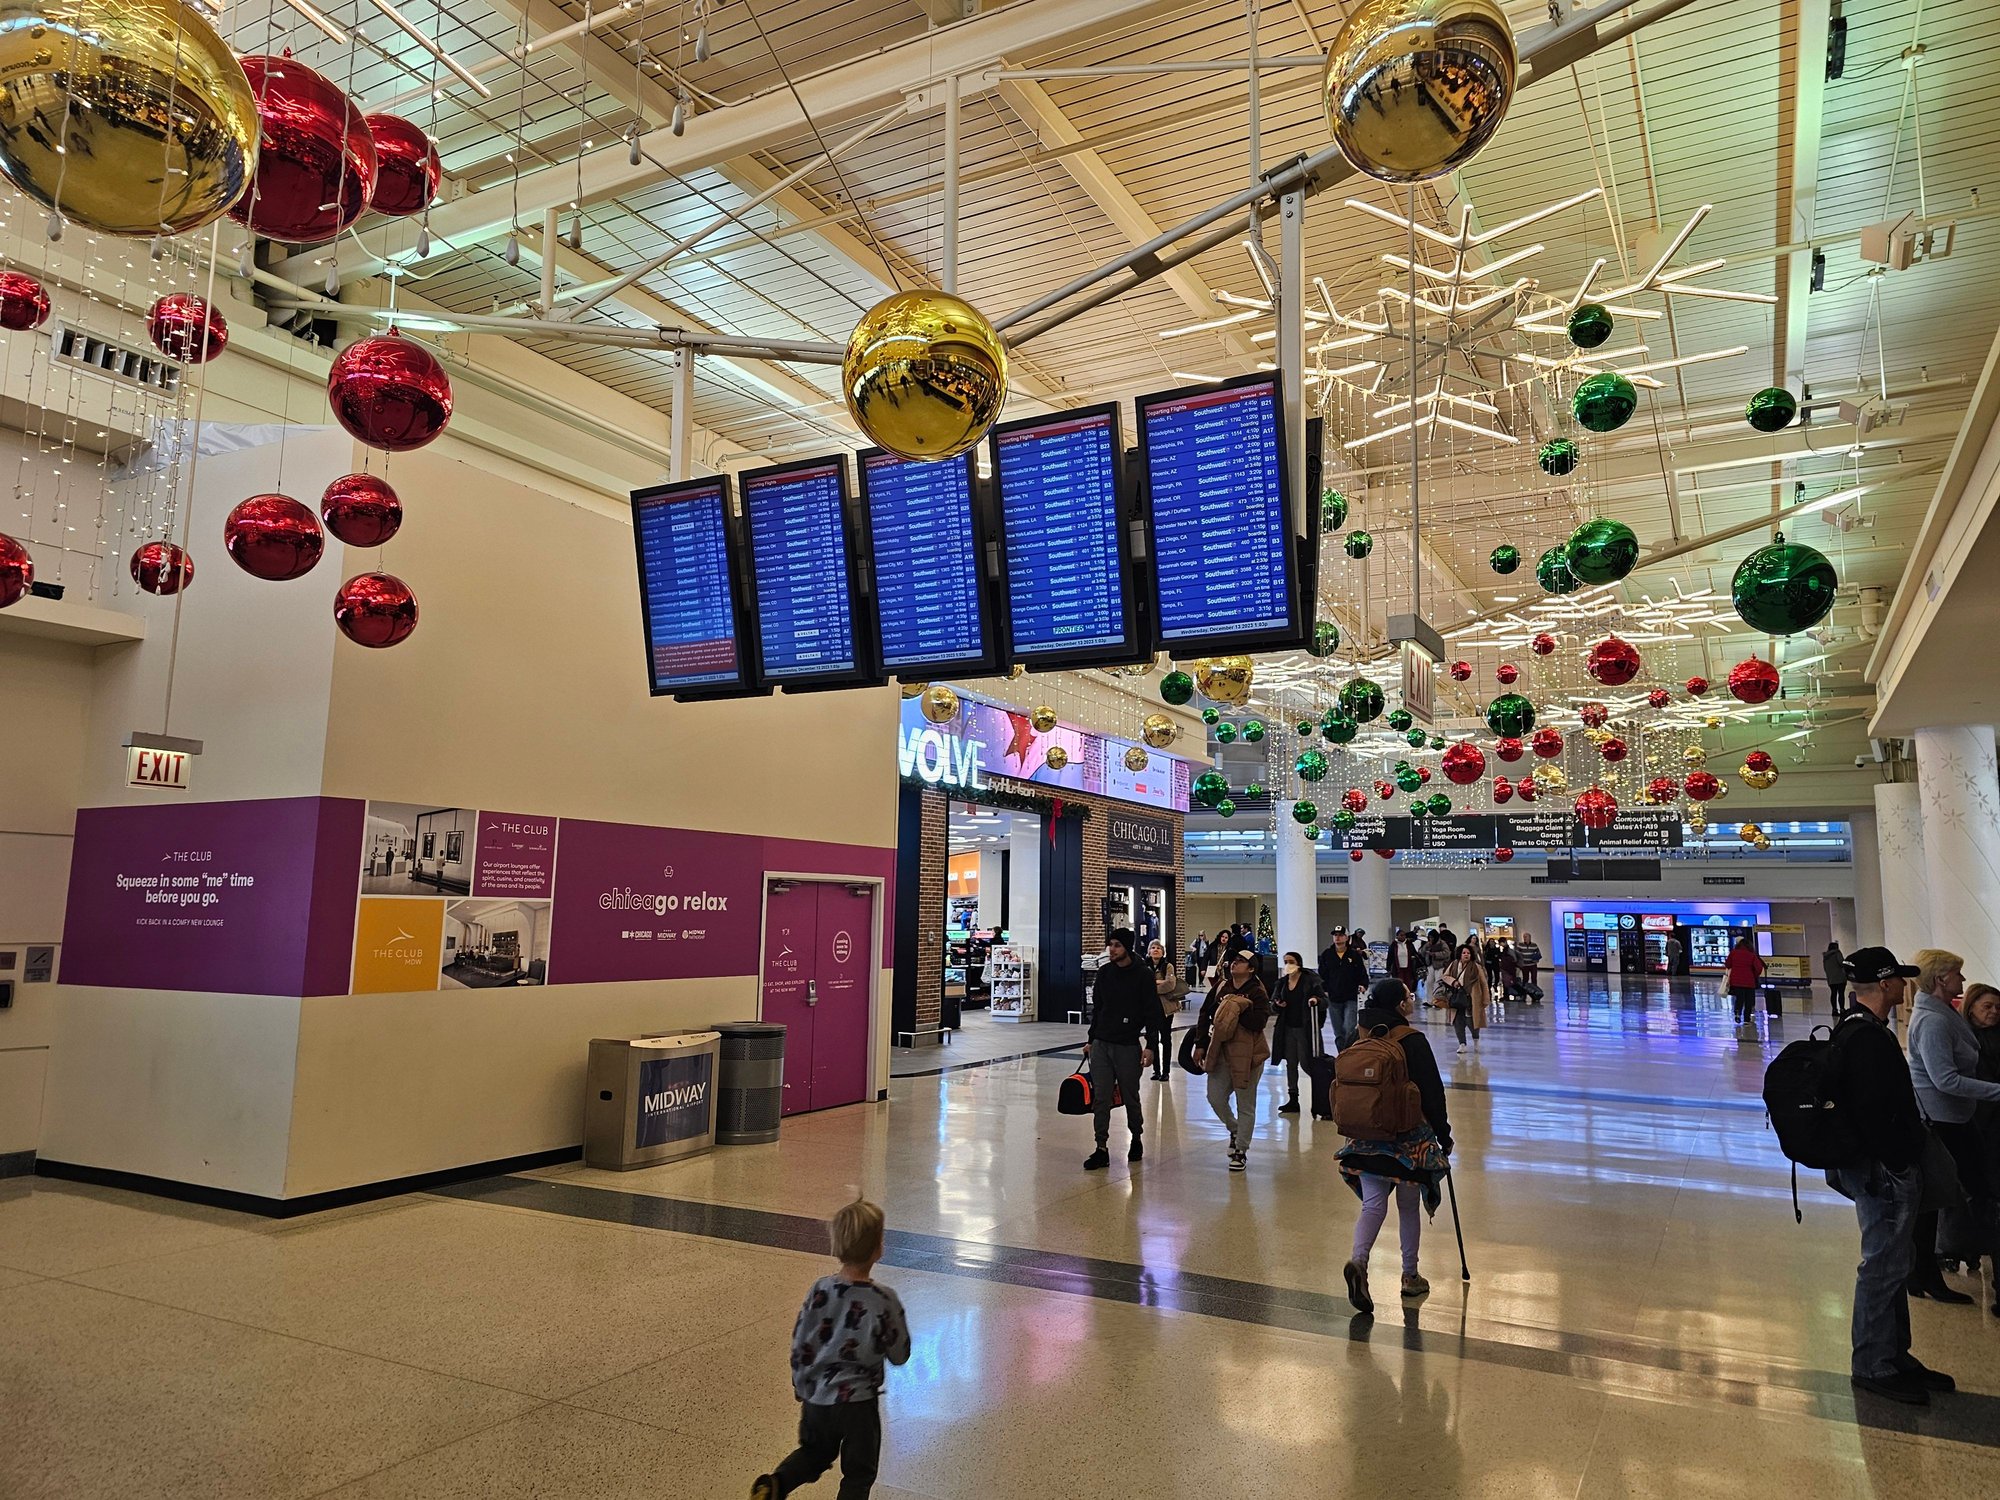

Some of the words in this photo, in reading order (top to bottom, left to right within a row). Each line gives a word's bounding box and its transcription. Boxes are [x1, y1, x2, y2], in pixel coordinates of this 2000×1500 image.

[1146, 408, 1169, 416] Departing
[1193, 406, 1222, 416] Southwest
[1148, 428, 1175, 438] Philadelphia,
[1194, 420, 1223, 430] Southwest
[998, 436, 1018, 444] Departing
[1149, 441, 1176, 451] Philadelphia,
[1195, 434, 1224, 444] Southwest
[1201, 515, 1230, 524] Southwest
[1202, 528, 1231, 537] Southwest
[1410, 649, 1430, 708] EXIT
[137, 751, 184, 782] EXIT
[988, 778, 998, 794] by
[1001, 778, 1035, 798] Hudson
[502, 823, 520, 833] THE
[523, 825, 548, 835] CLUB
[1114, 821, 1159, 846] CHICAGO,
[1162, 829, 1169, 845] IL
[173, 852, 188, 861] THE
[190, 851, 211, 861] CLUB
[117, 874, 157, 890] Squeeze
[160, 874, 169, 887] in
[172, 877, 199, 887] some
[230, 873, 254, 886] time
[146, 890, 178, 903] before
[180, 893, 200, 907] you
[202, 893, 219, 907] go.
[599, 887, 678, 916] chicago
[683, 891, 728, 910] relax
[374, 950, 392, 958] THE
[396, 949, 422, 958] CLUB
[645, 1082, 706, 1113] MIDWAY
[646, 1106, 684, 1117] INTERNATIONAL
[687, 1100, 703, 1108] AIRPORT
